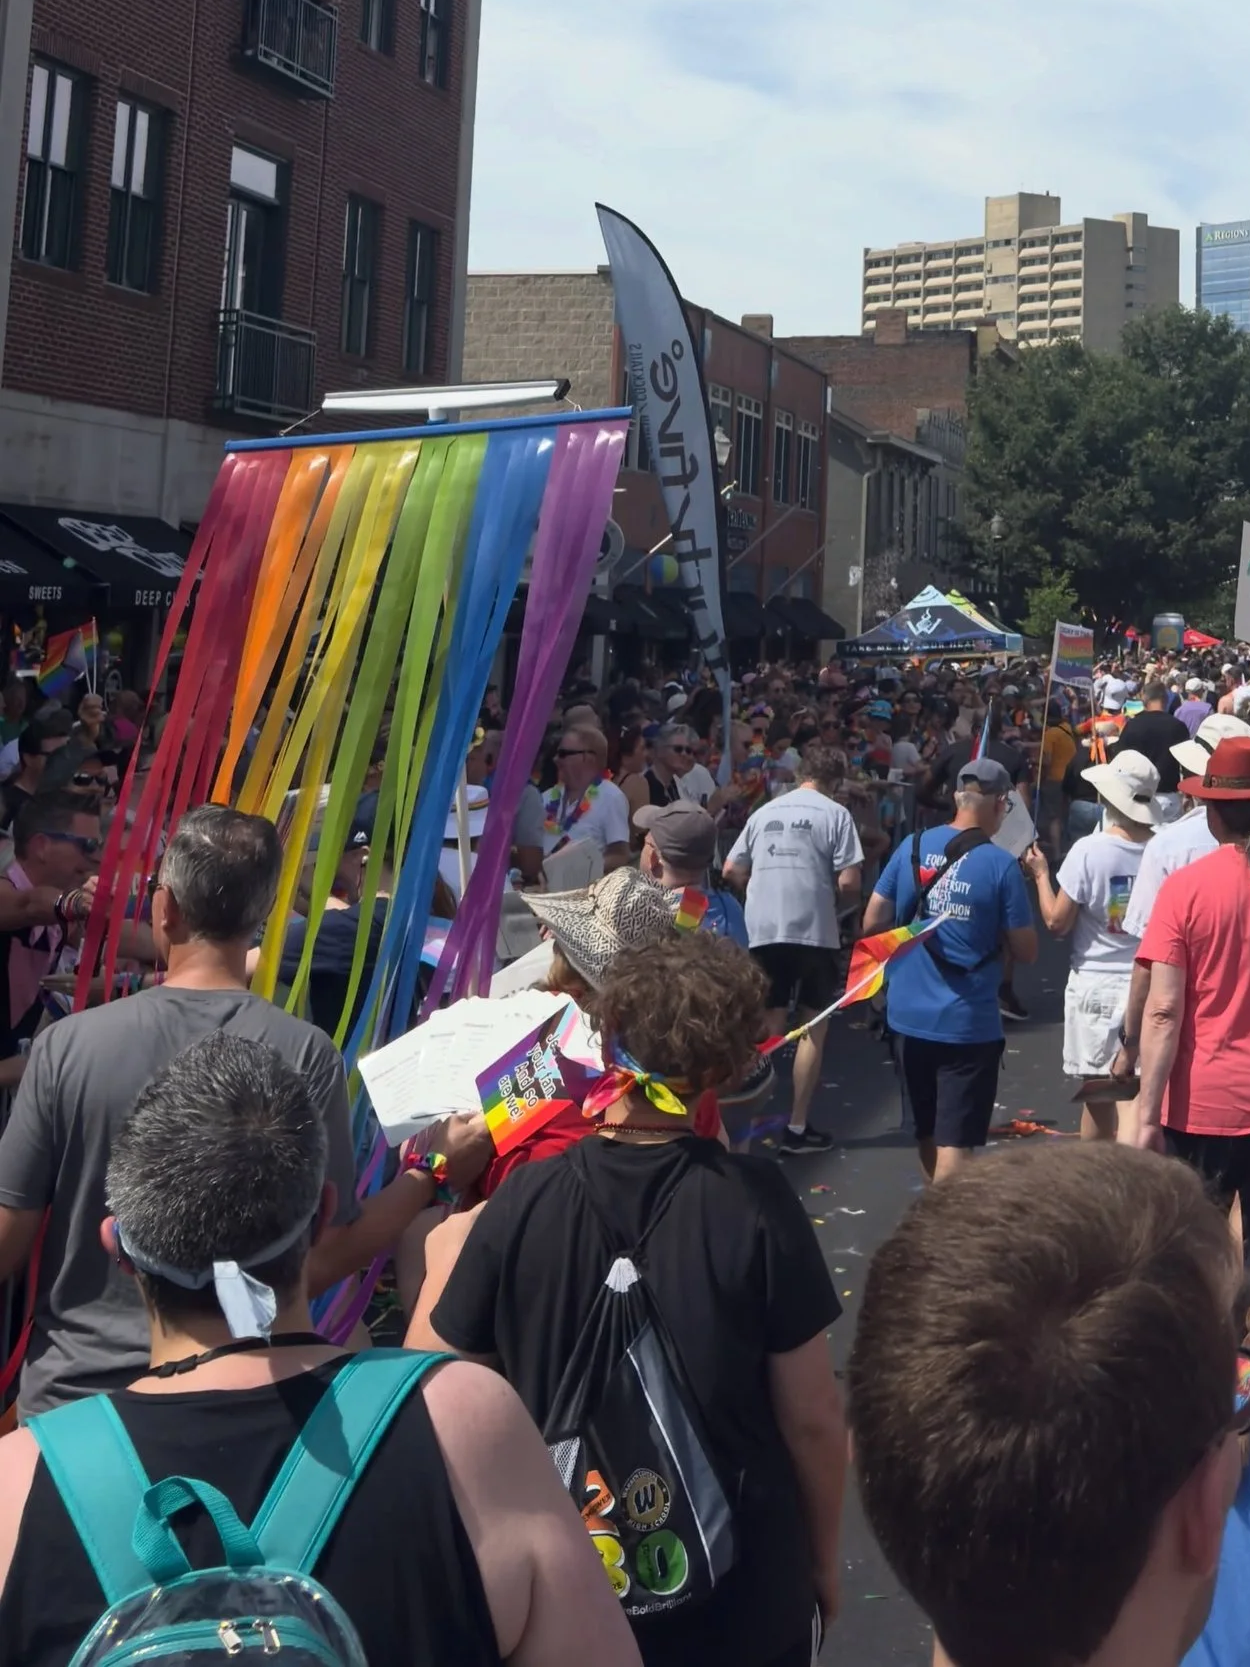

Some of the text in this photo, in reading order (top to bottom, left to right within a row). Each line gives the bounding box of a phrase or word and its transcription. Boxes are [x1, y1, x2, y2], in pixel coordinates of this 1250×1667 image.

[28, 586, 62, 600] SWEETS
[134, 589, 162, 606] DEEP
[929, 899, 971, 916] INCLUSION
[528, 1043, 546, 1072] your
[514, 1062, 538, 1107] And so
[498, 1075, 524, 1122] are we!
